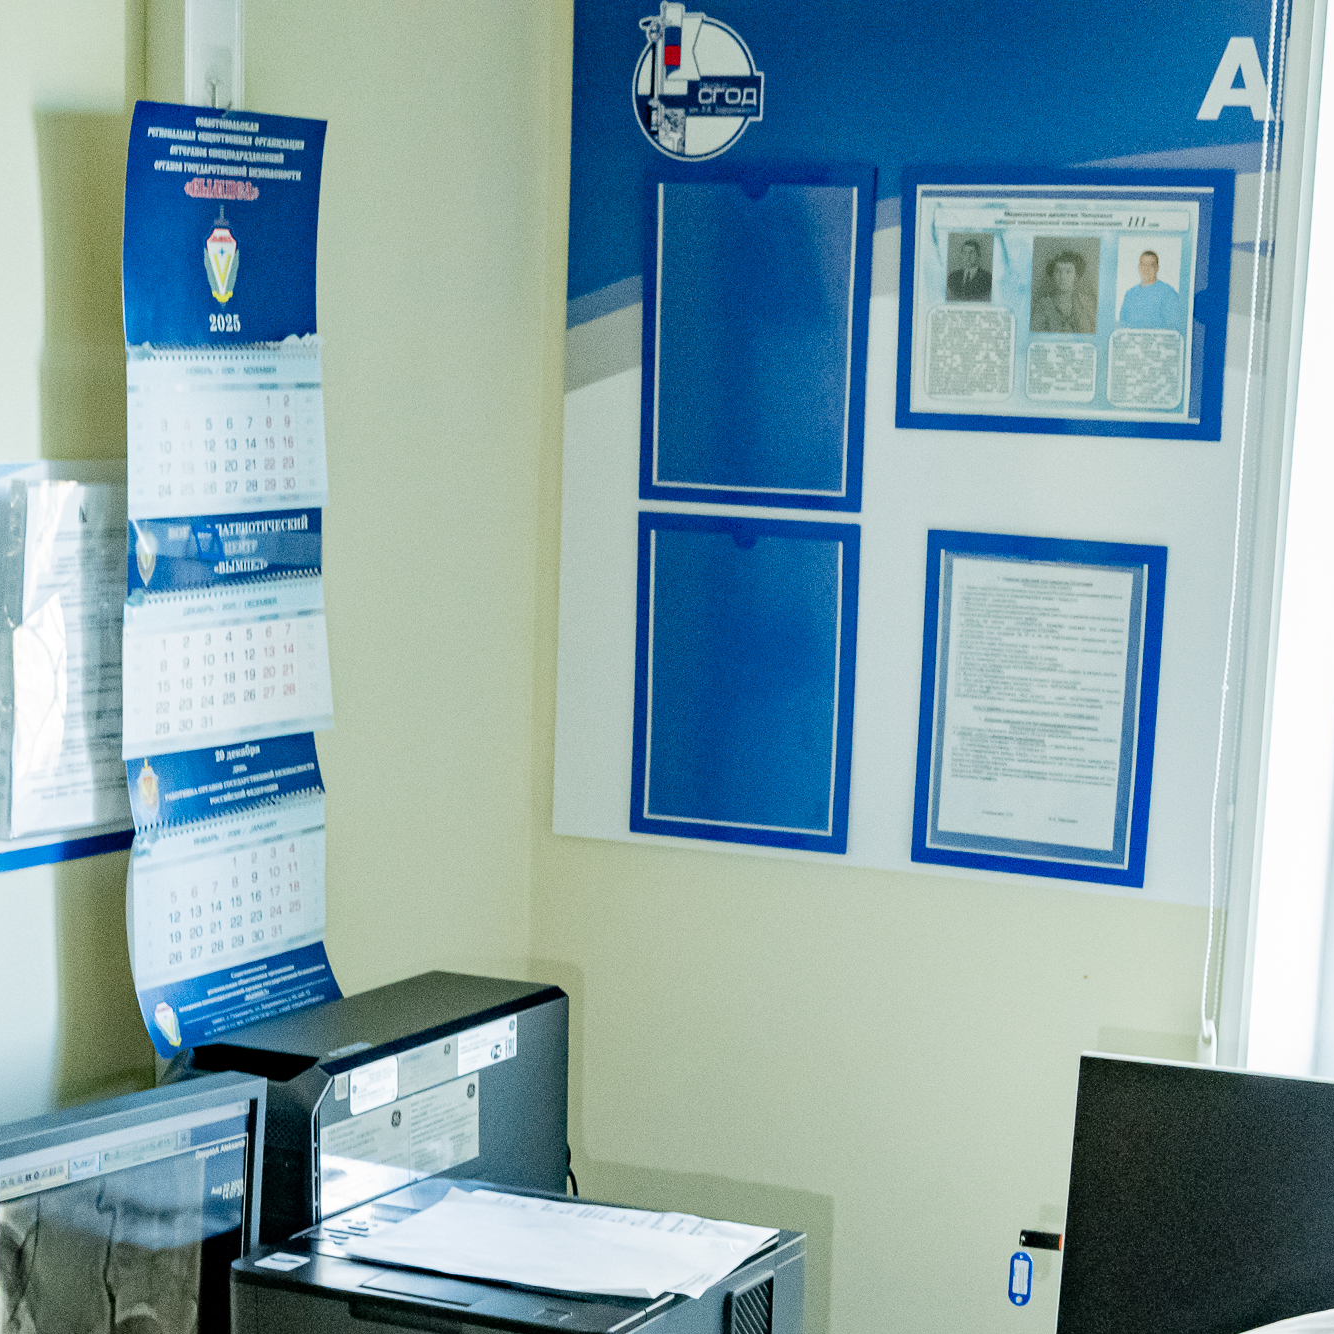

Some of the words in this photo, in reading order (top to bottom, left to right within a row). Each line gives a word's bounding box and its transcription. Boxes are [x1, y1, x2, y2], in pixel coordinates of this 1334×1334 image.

[209, 314, 241, 332] 2025
[284, 394, 289, 407] 2
[227, 417, 233, 430] 6
[248, 417, 252, 428] 7
[285, 415, 290, 427] 9
[225, 439, 236, 450] 13
[246, 438, 256, 450] 14
[225, 459, 237, 471] 20
[246, 459, 256, 471] 21
[265, 458, 275, 469] 22
[283, 457, 294, 469] 23
[226, 481, 237, 493] 27
[246, 480, 257, 492] 28
[284, 478, 295, 489] 30
[205, 634, 211, 646] 3
[226, 631, 231, 643] 4
[247, 629, 252, 640] 5
[285, 623, 290, 635] 7
[203, 654, 214, 665] 10
[225, 652, 234, 663] 11
[245, 649, 255, 661] 12
[264, 646, 275, 658] 13
[284, 644, 294, 654] 14
[202, 674, 214, 686] 17
[224, 672, 235, 684] 18
[245, 669, 255, 681] 19
[264, 666, 275, 679] 20
[283, 664, 293, 676] 21
[223, 693, 235, 705] 25
[244, 690, 255, 701] 26
[264, 686, 275, 698] 27
[283, 683, 295, 696] 28
[201, 716, 213, 728] 31
[227, 744, 260, 761] декабря
[289, 843, 295, 852] 4
[252, 871, 257, 883] 9
[269, 866, 280, 878] 10
[289, 861, 297, 873] 11
[169, 911, 180, 923] 12
[191, 906, 201, 918] 13
[211, 901, 221, 913] 14
[232, 895, 242, 908] 15
[251, 890, 261, 902] 16
[270, 886, 280, 897] 17
[289, 881, 300, 892] 18
[171, 931, 181, 943] 19
[190, 926, 202, 939] 20
[210, 920, 221, 934] 21
[231, 915, 242, 928] 22
[251, 910, 262, 923] 23
[270, 905, 282, 918] 24
[289, 900, 301, 913] 25
[169, 952, 182, 965] 26
[191, 946, 203, 960] 27
[211, 940, 223, 953] 28
[232, 935, 244, 948] 29
[252, 930, 264, 942] 30
[272, 924, 282, 937] 31
